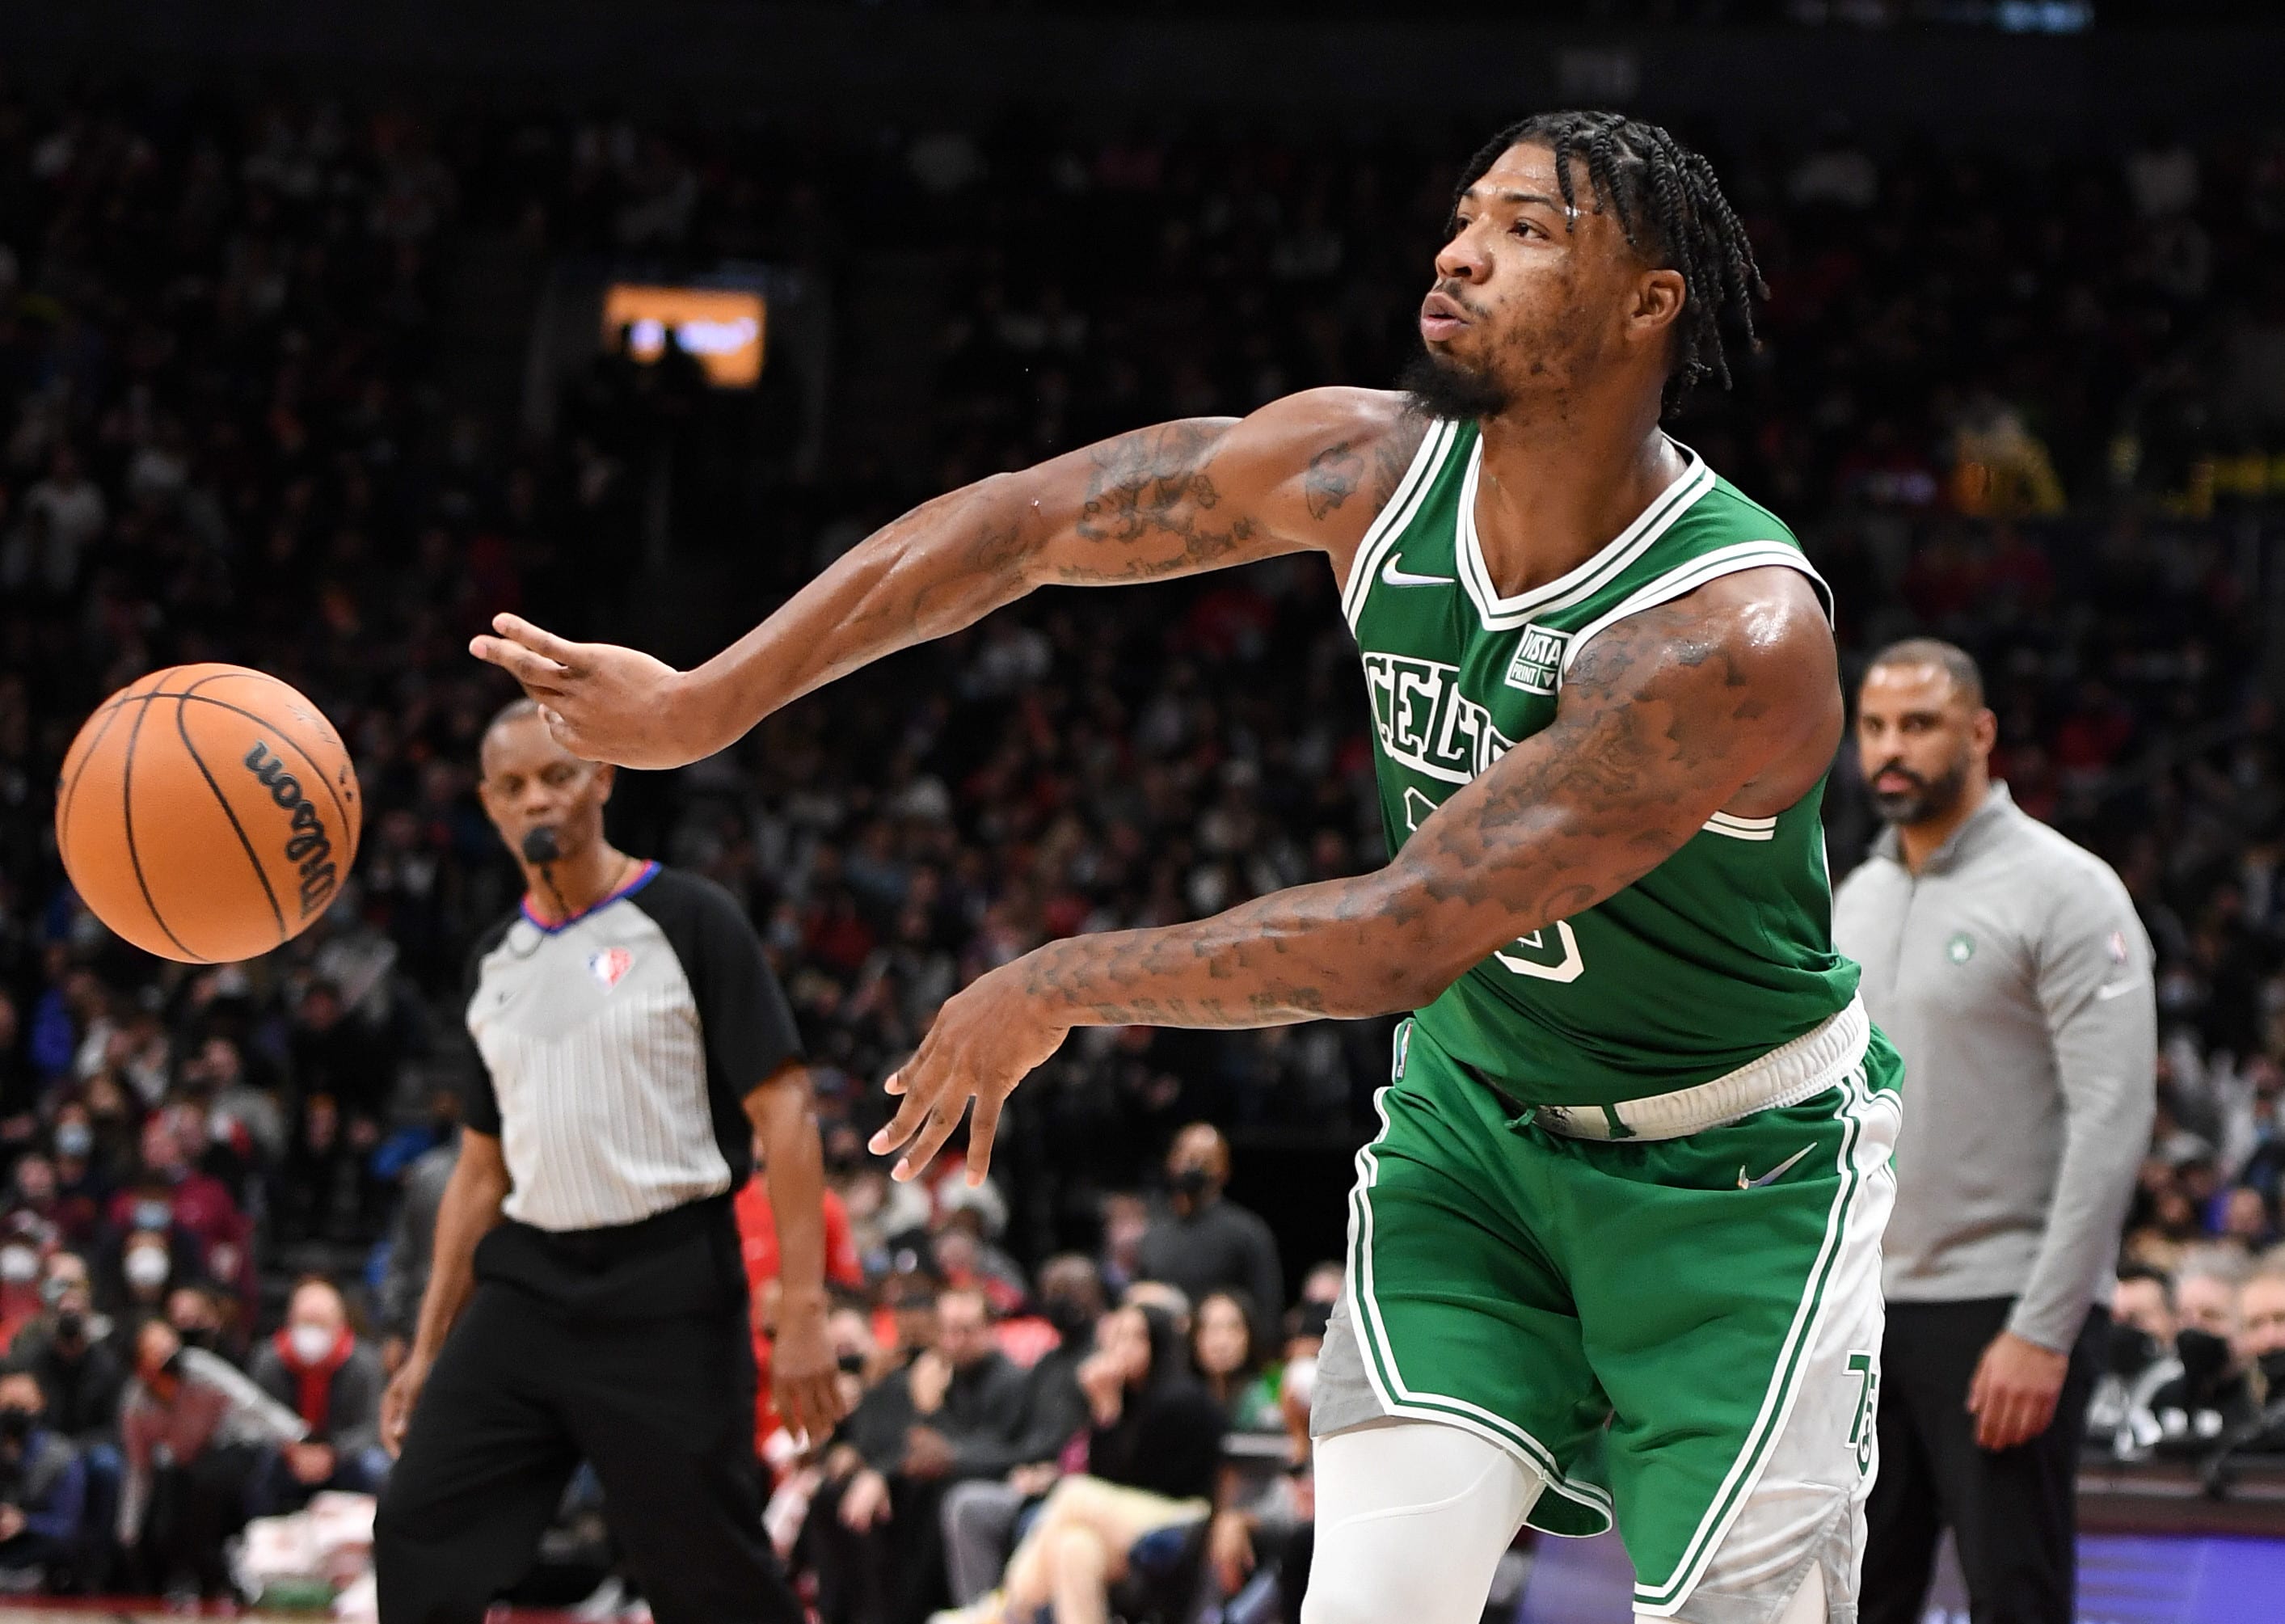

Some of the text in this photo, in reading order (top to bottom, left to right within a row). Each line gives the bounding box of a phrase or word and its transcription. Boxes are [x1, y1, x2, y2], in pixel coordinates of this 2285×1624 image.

[1521, 633, 1562, 666] VISTA
[1511, 664, 1537, 685] PRINT
[244, 739, 336, 919] Wilson
